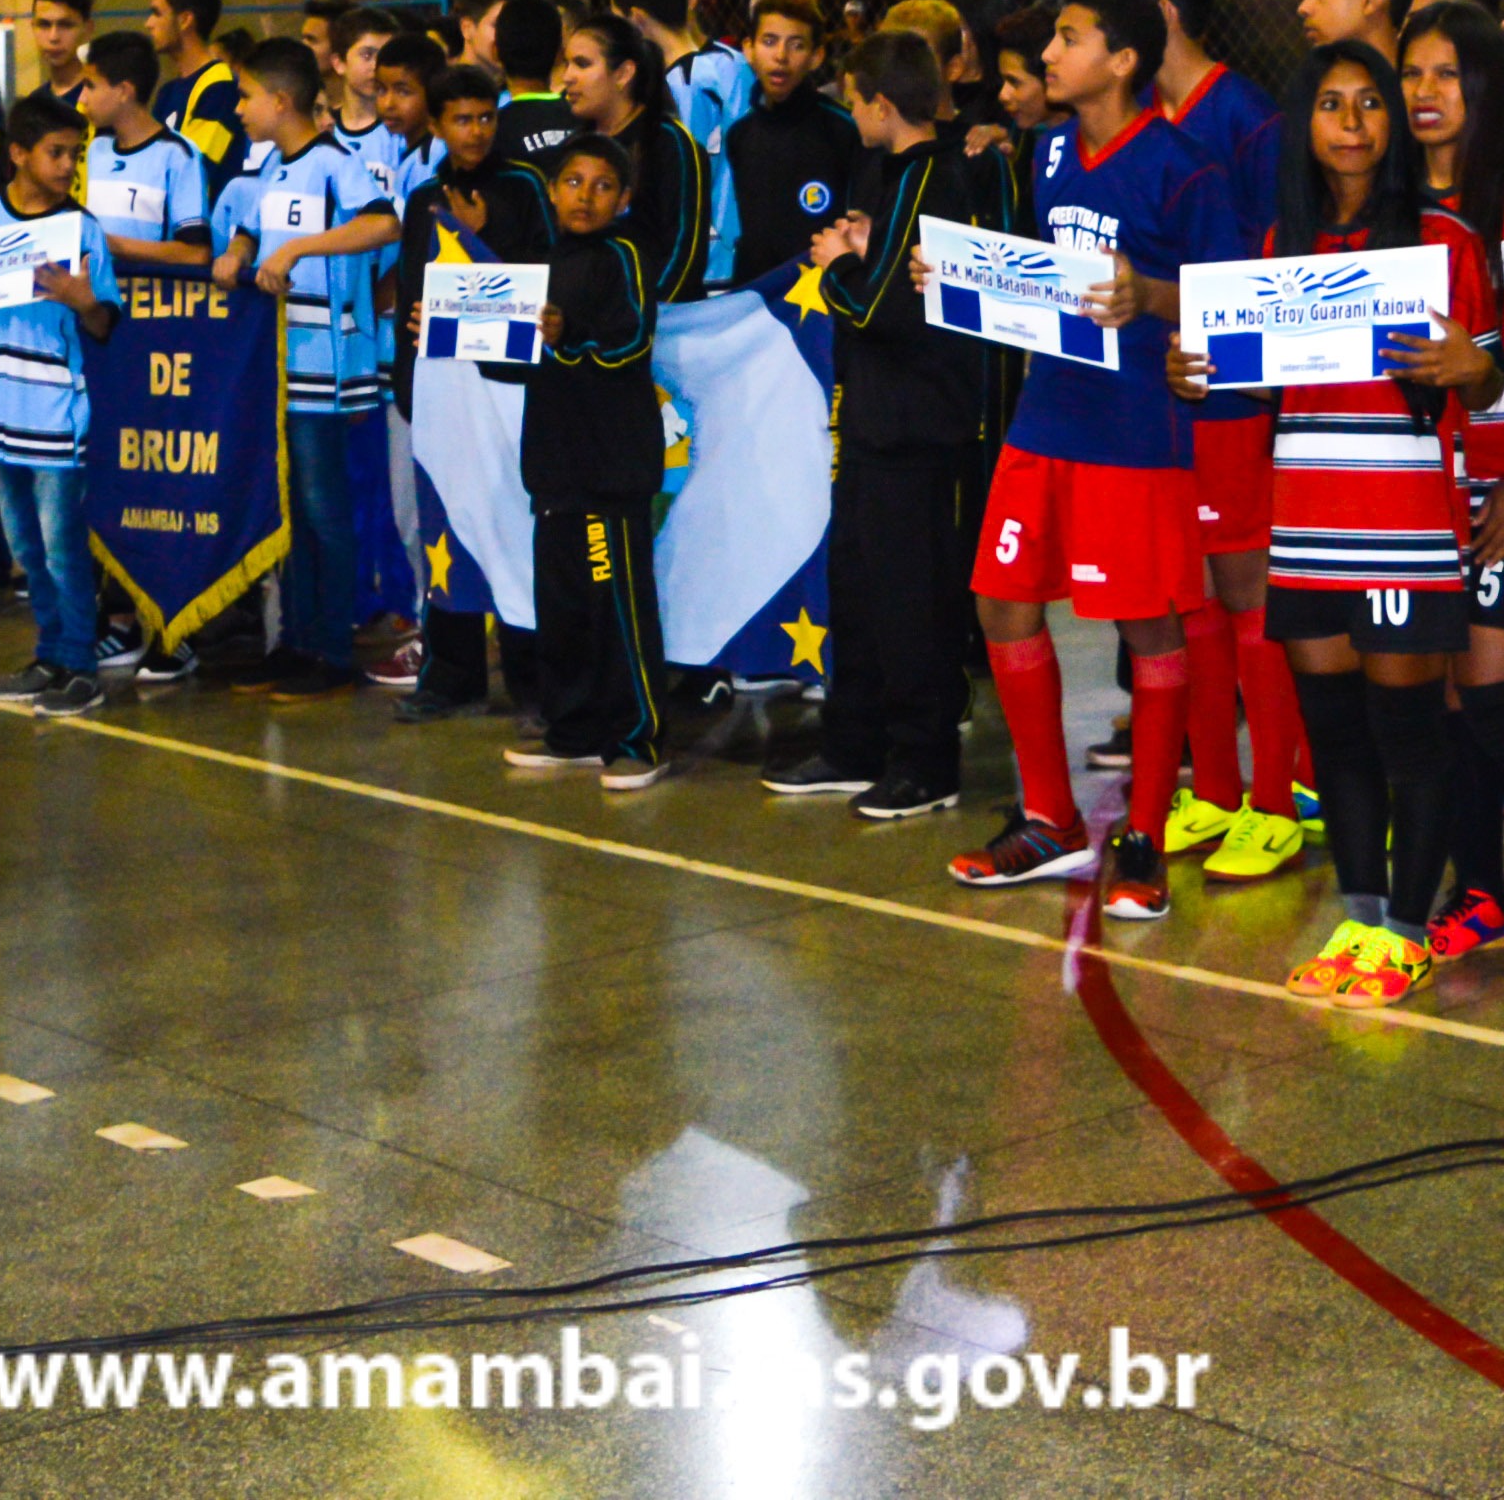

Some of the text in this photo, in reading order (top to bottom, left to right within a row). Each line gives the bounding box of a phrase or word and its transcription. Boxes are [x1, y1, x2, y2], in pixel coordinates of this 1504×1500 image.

[1046, 136, 1065, 178] 5
[128, 188, 137, 212] 7
[287, 199, 301, 226] 6
[942, 261, 961, 280] E.M.
[965, 267, 993, 287] Maria
[997, 274, 1040, 298] Bataglin
[1202, 311, 1230, 329] E.M.
[1275, 305, 1304, 325] Eroy
[1310, 300, 1367, 321] Guarani
[1372, 295, 1425, 317] Kaiowá
[149, 352, 192, 396] DE
[119, 427, 219, 474] BRUM
[120, 506, 183, 533] AMAMBAI
[194, 511, 220, 536] MS
[996, 518, 1022, 564] 5
[1477, 560, 1504, 607] 5
[1366, 588, 1409, 626] 10
